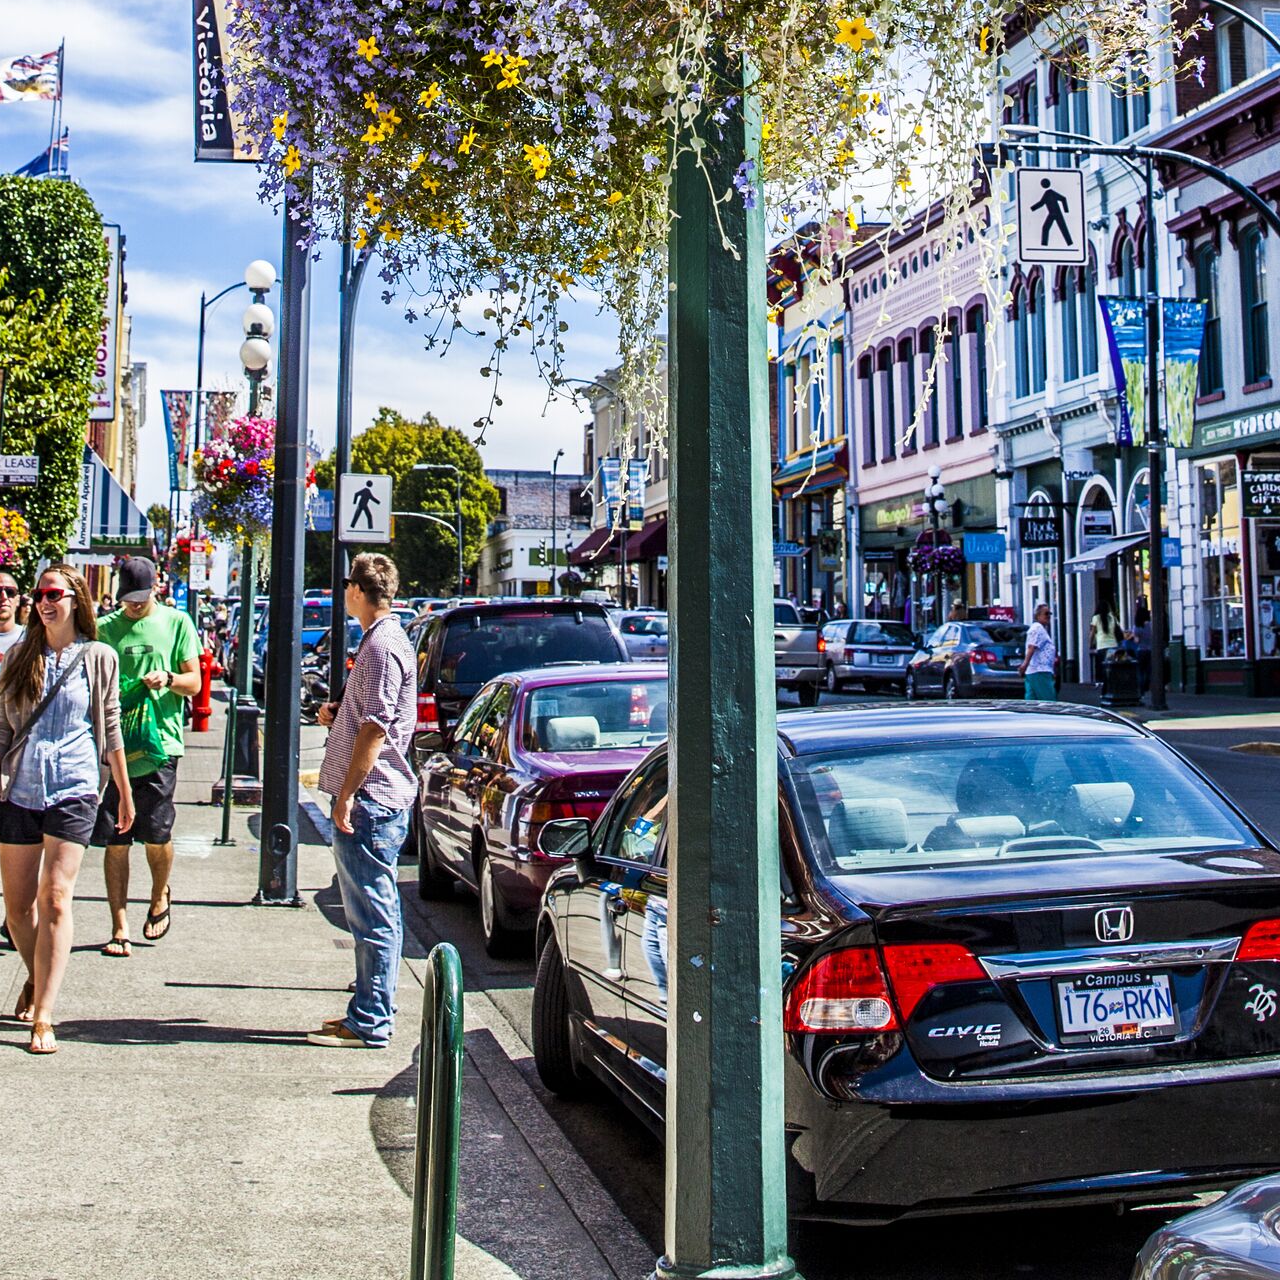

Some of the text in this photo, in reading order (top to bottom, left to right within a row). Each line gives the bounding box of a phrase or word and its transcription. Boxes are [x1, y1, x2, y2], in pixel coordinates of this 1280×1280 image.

[195, 4, 223, 142] Victoria
[4, 458, 37, 468] LEASE
[1085, 973, 1141, 987] Campus
[1064, 988, 1172, 1024] 176 RKN
[928, 1023, 1002, 1038] CIVIC
[1090, 1032, 1131, 1043] VICTORIA
